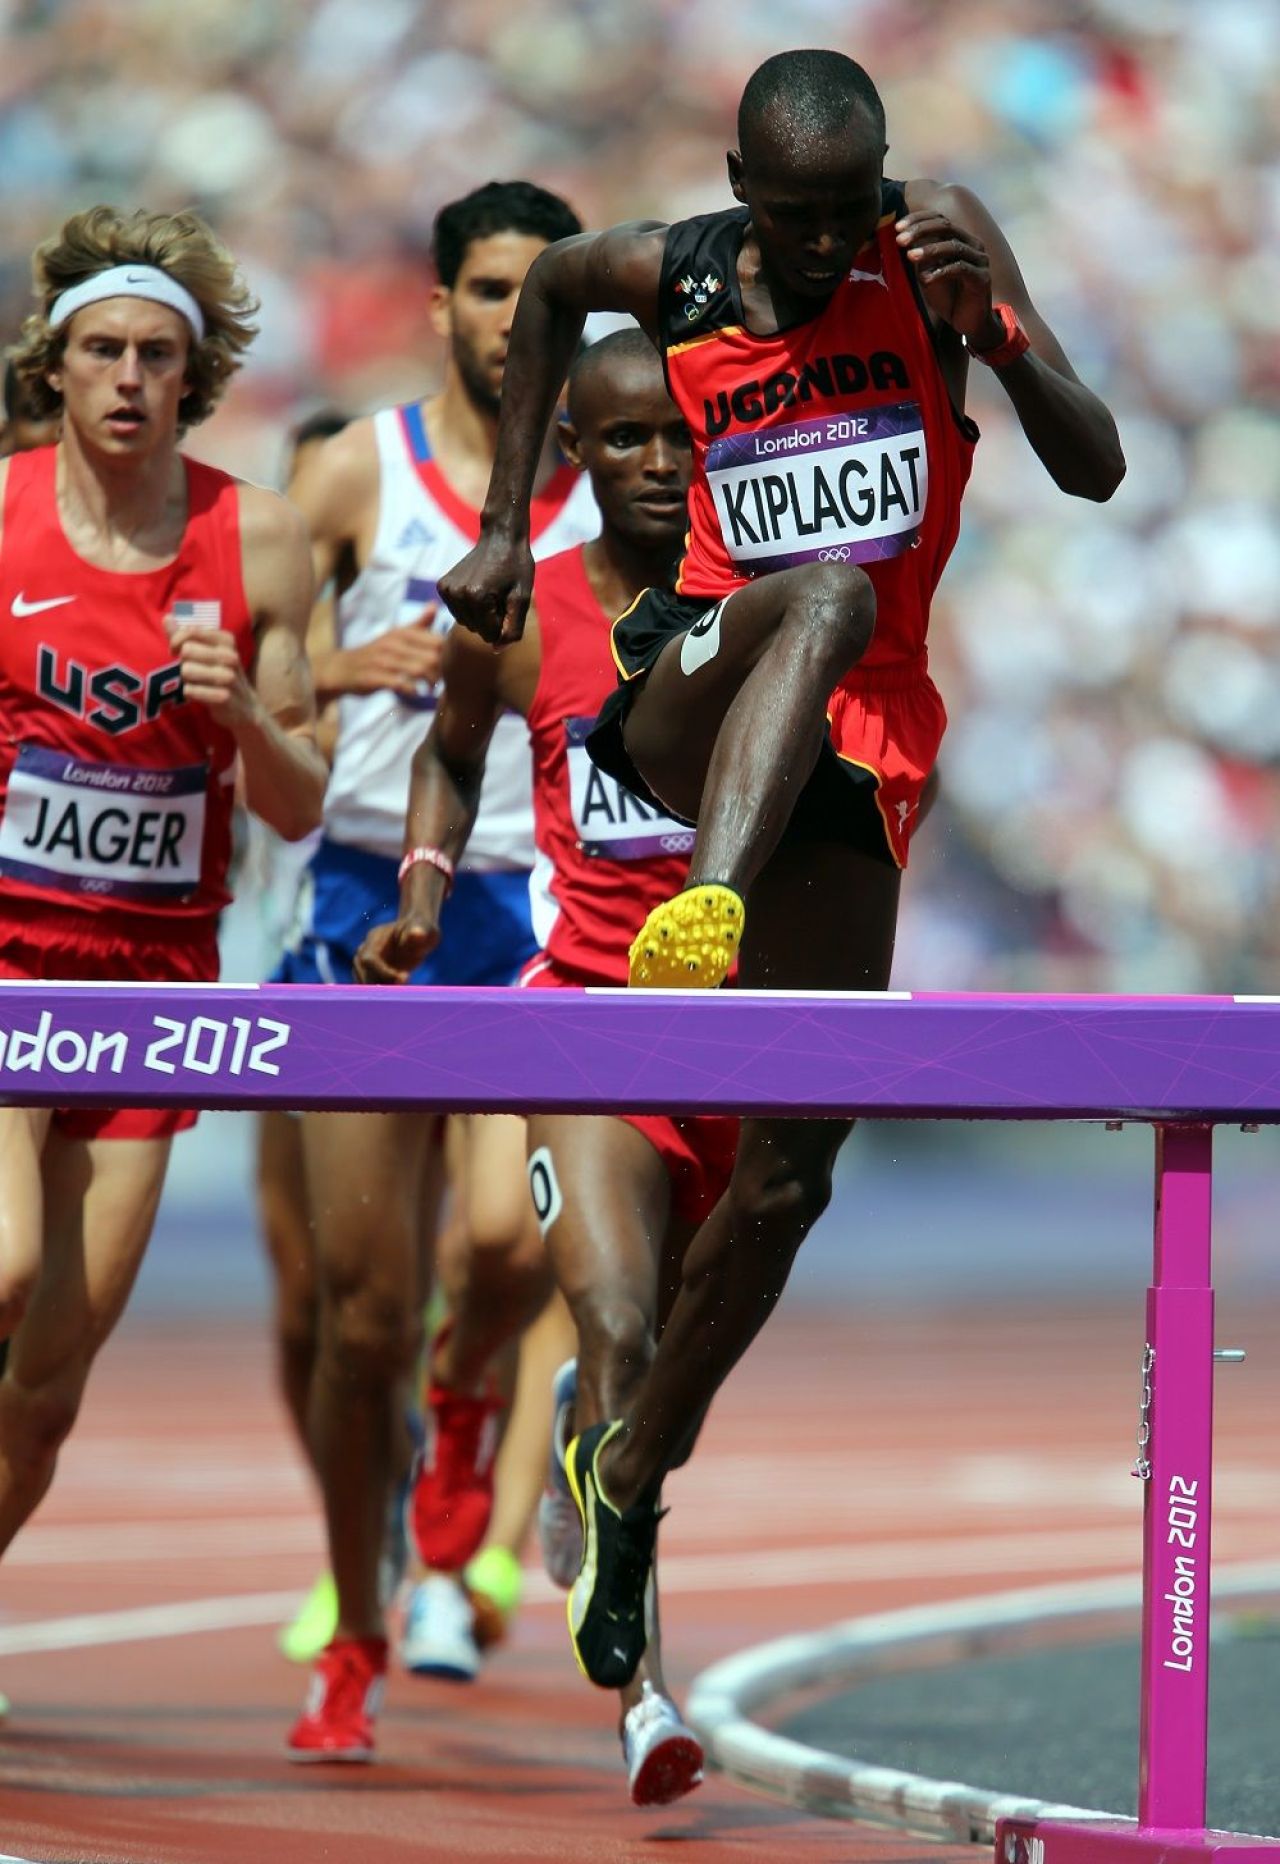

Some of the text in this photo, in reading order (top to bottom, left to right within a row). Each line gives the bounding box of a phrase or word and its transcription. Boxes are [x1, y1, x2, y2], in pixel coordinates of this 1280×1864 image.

[703, 351, 910, 436] UGANDA
[755, 418, 868, 455] London 2012
[722, 447, 921, 547] KIPLAGAT
[36, 642, 186, 735] USA
[62, 762, 174, 792] London 2012
[23, 797, 187, 869] JAGER
[0, 1010, 291, 1077] don 2012
[1164, 1475, 1198, 1672] London 2012
